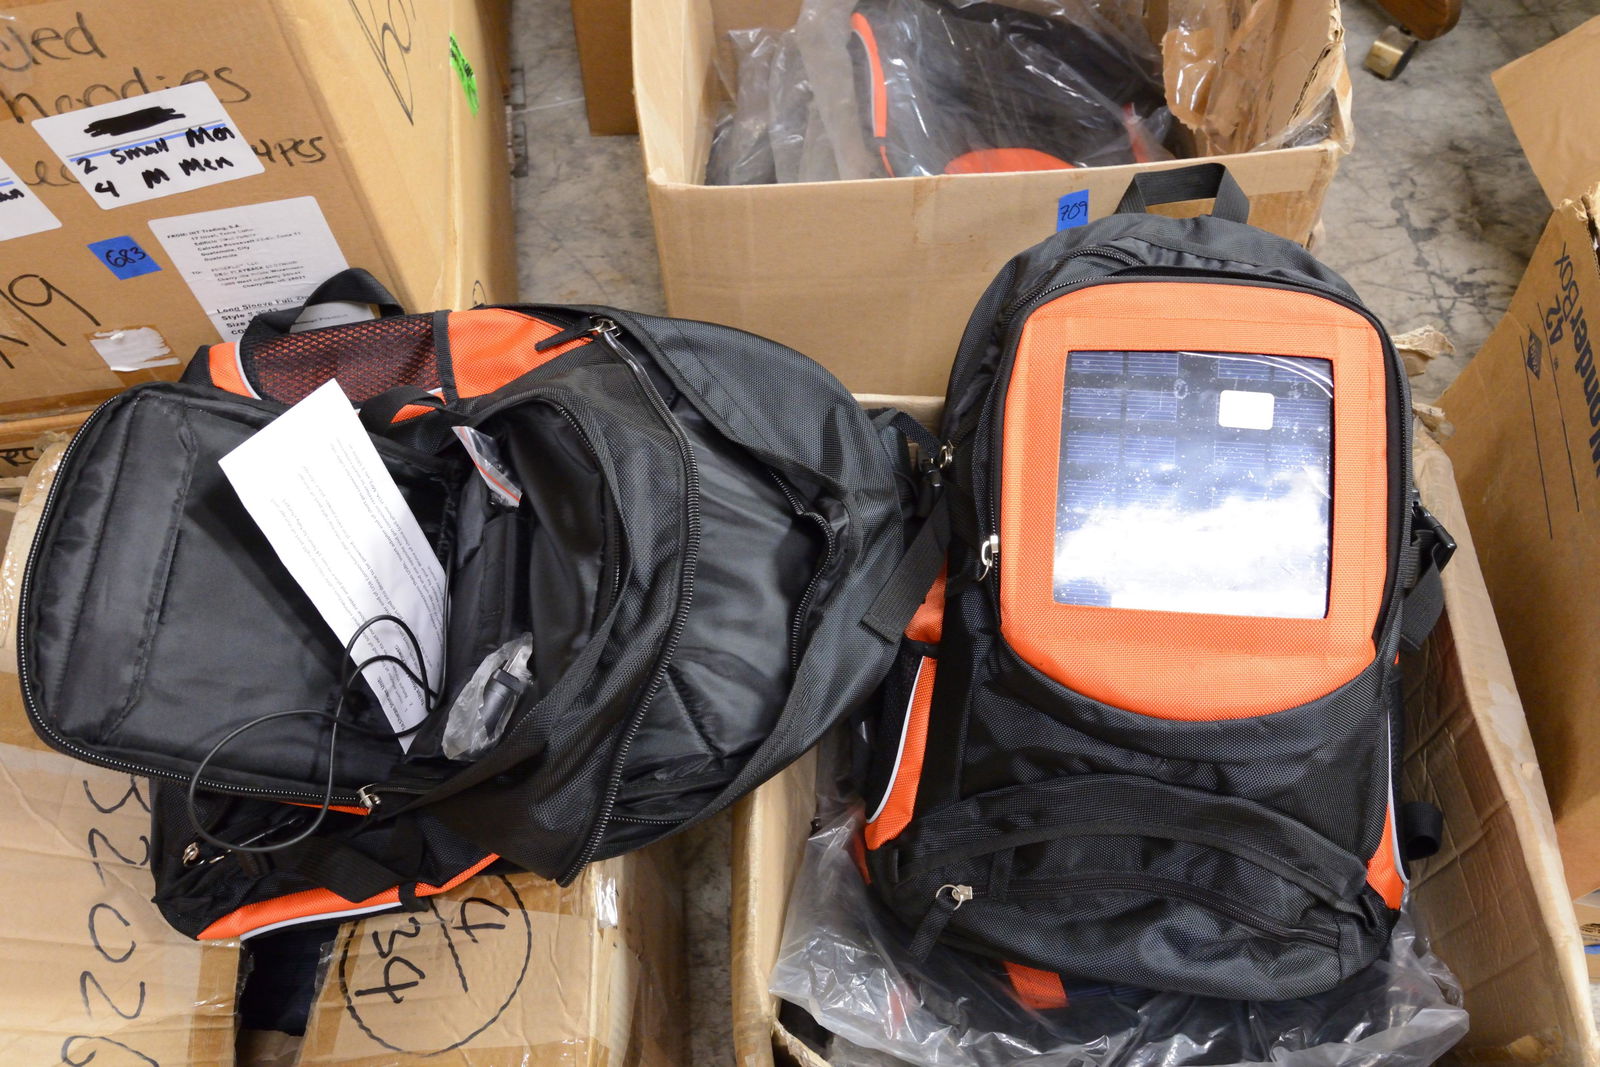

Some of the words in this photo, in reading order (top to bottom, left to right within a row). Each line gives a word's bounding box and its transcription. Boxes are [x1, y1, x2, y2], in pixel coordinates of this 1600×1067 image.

[77, 157, 98, 175] 2
[110, 137, 170, 165] Small
[94, 180, 120, 198] 4
[141, 168, 171, 189] M
[178, 156, 234, 177] Men
[1060, 200, 1088, 222] 709
[105, 234, 147, 268] 683
[1545, 294, 1565, 346] 42
